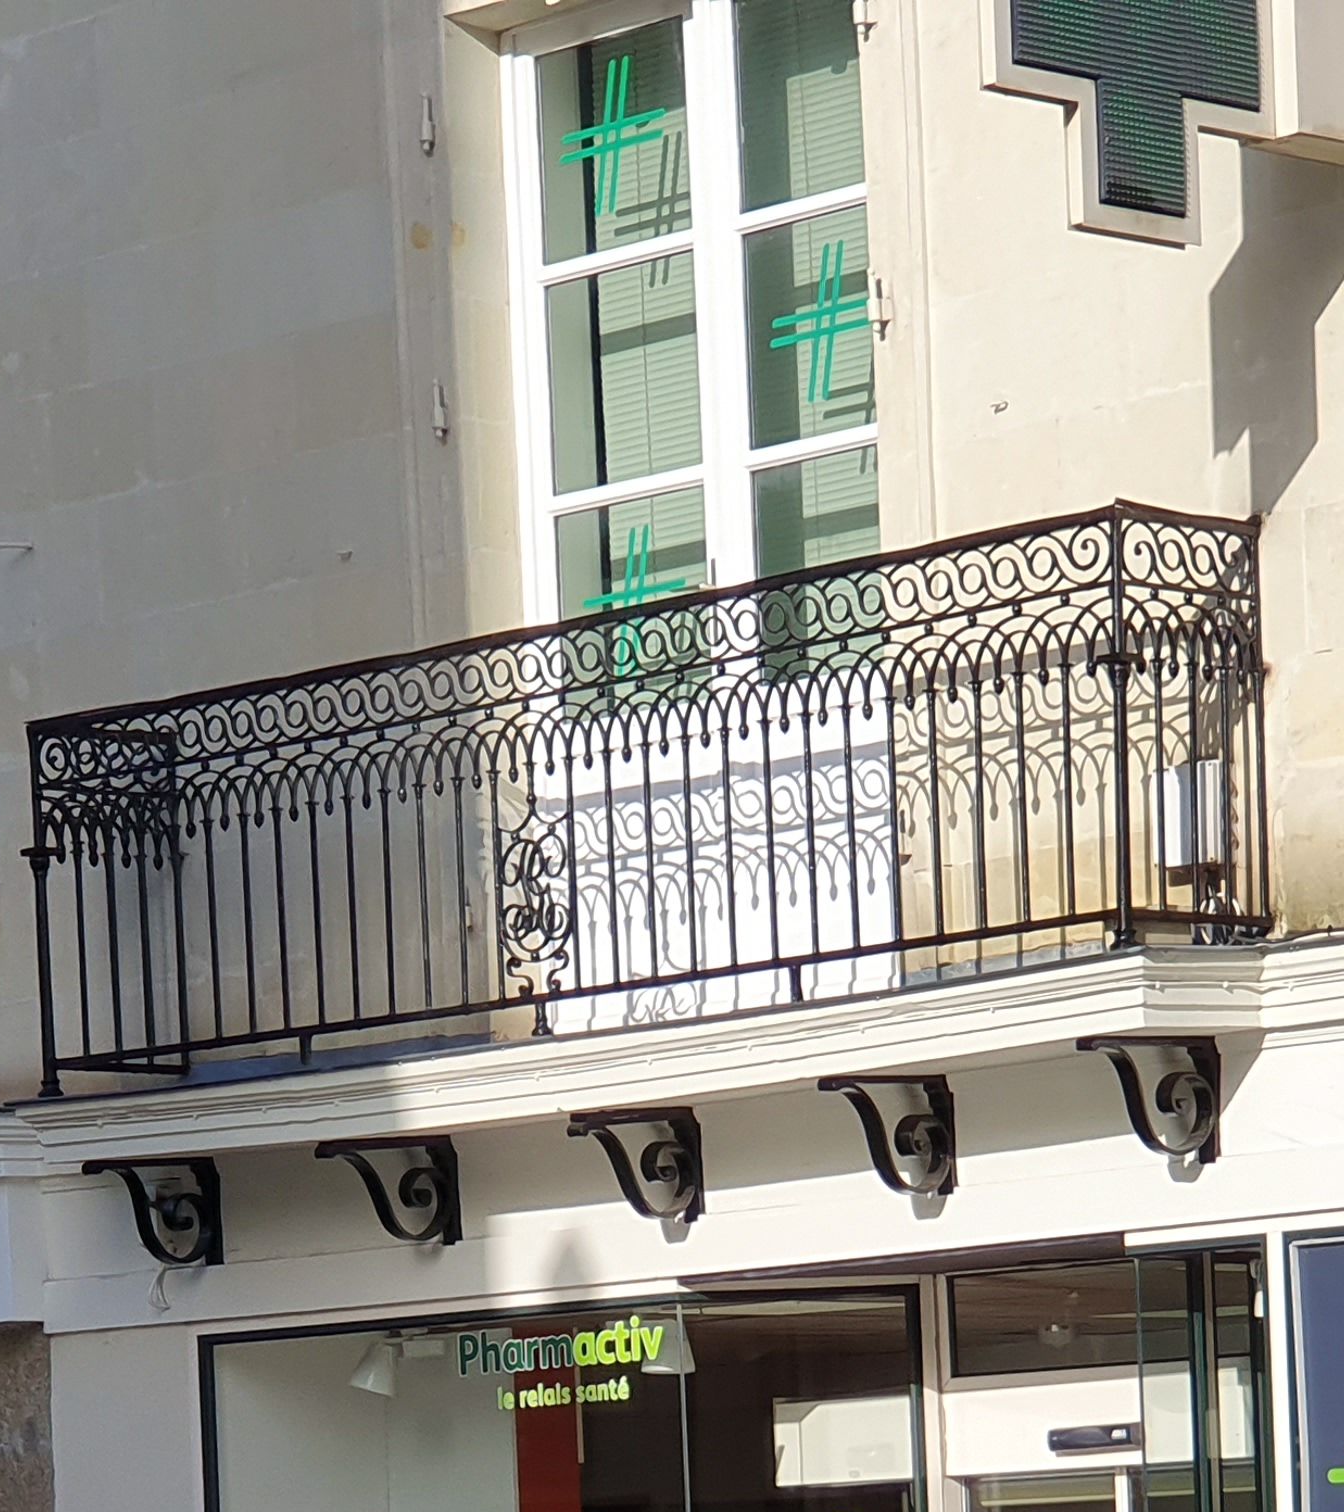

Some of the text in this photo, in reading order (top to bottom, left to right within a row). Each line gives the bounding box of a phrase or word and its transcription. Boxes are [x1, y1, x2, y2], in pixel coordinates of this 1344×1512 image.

[458, 1315, 663, 1377] Pharmactiv
[497, 1376, 630, 1410] le relais santé
